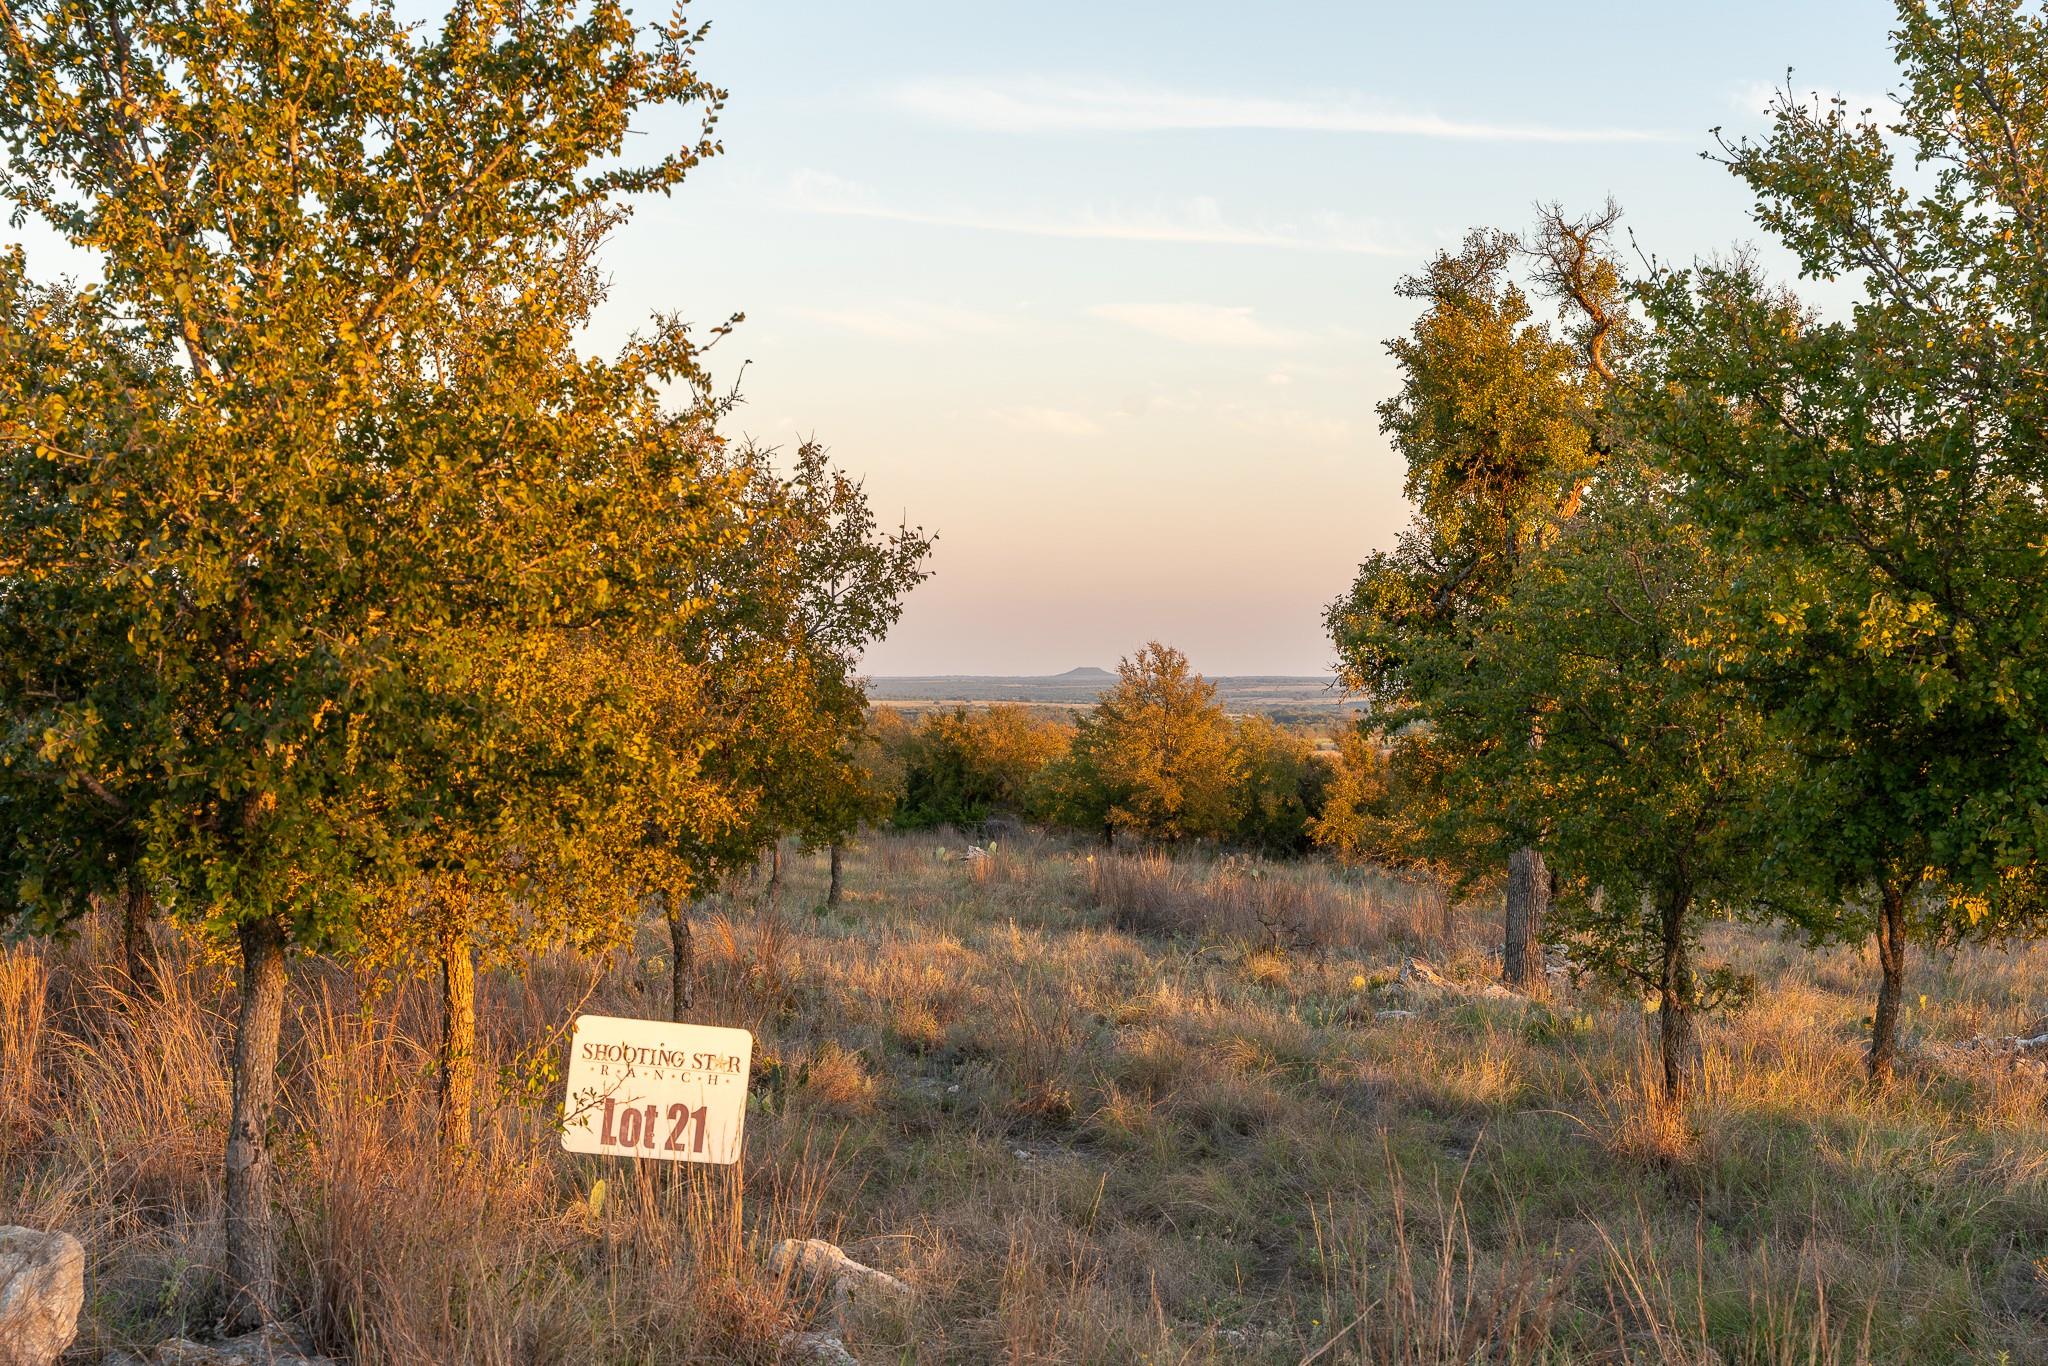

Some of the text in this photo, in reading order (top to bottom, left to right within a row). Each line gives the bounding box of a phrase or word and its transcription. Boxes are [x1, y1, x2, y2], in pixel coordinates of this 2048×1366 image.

[582, 1042, 741, 1073] SHOOTING STR
[600, 1098, 707, 1153] Lot 21
